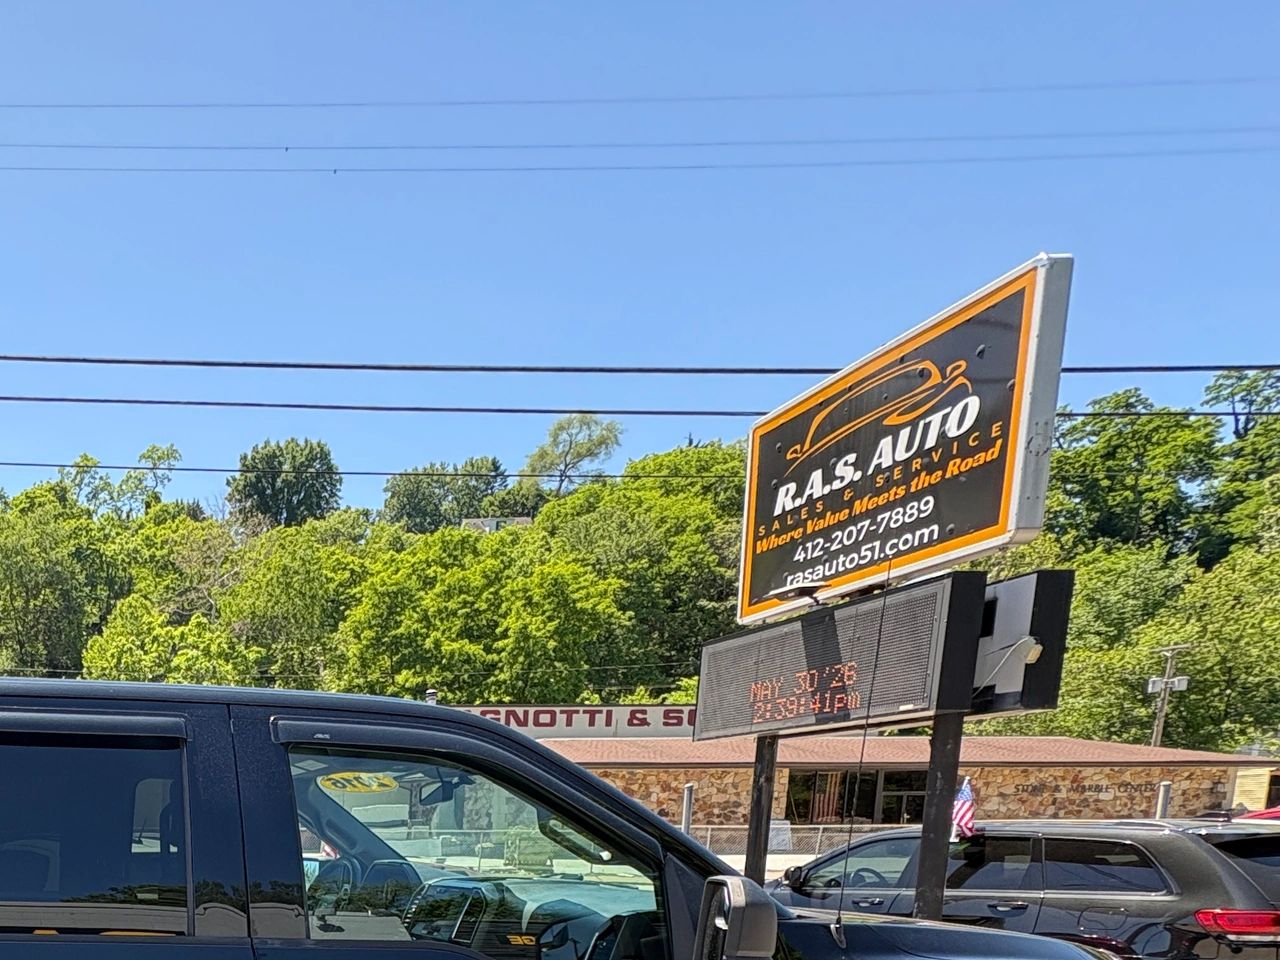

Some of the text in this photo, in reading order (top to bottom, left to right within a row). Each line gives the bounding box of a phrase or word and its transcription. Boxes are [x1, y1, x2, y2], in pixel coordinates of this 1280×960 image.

[758, 421, 1003, 537] SALES & SERVICE
[773, 395, 981, 517] R.A.S. AUTO
[755, 439, 1003, 555] Where Value Meets the Road
[793, 495, 935, 563] 412-207-7889
[786, 524, 939, 588] rasauto51.com
[627, 709, 651, 727] &
[751, 676, 784, 701] MAY
[793, 669, 818, 694] 30
[1068, 784, 1111, 793] MARBLE
[1118, 783, 1158, 793] CENTER
